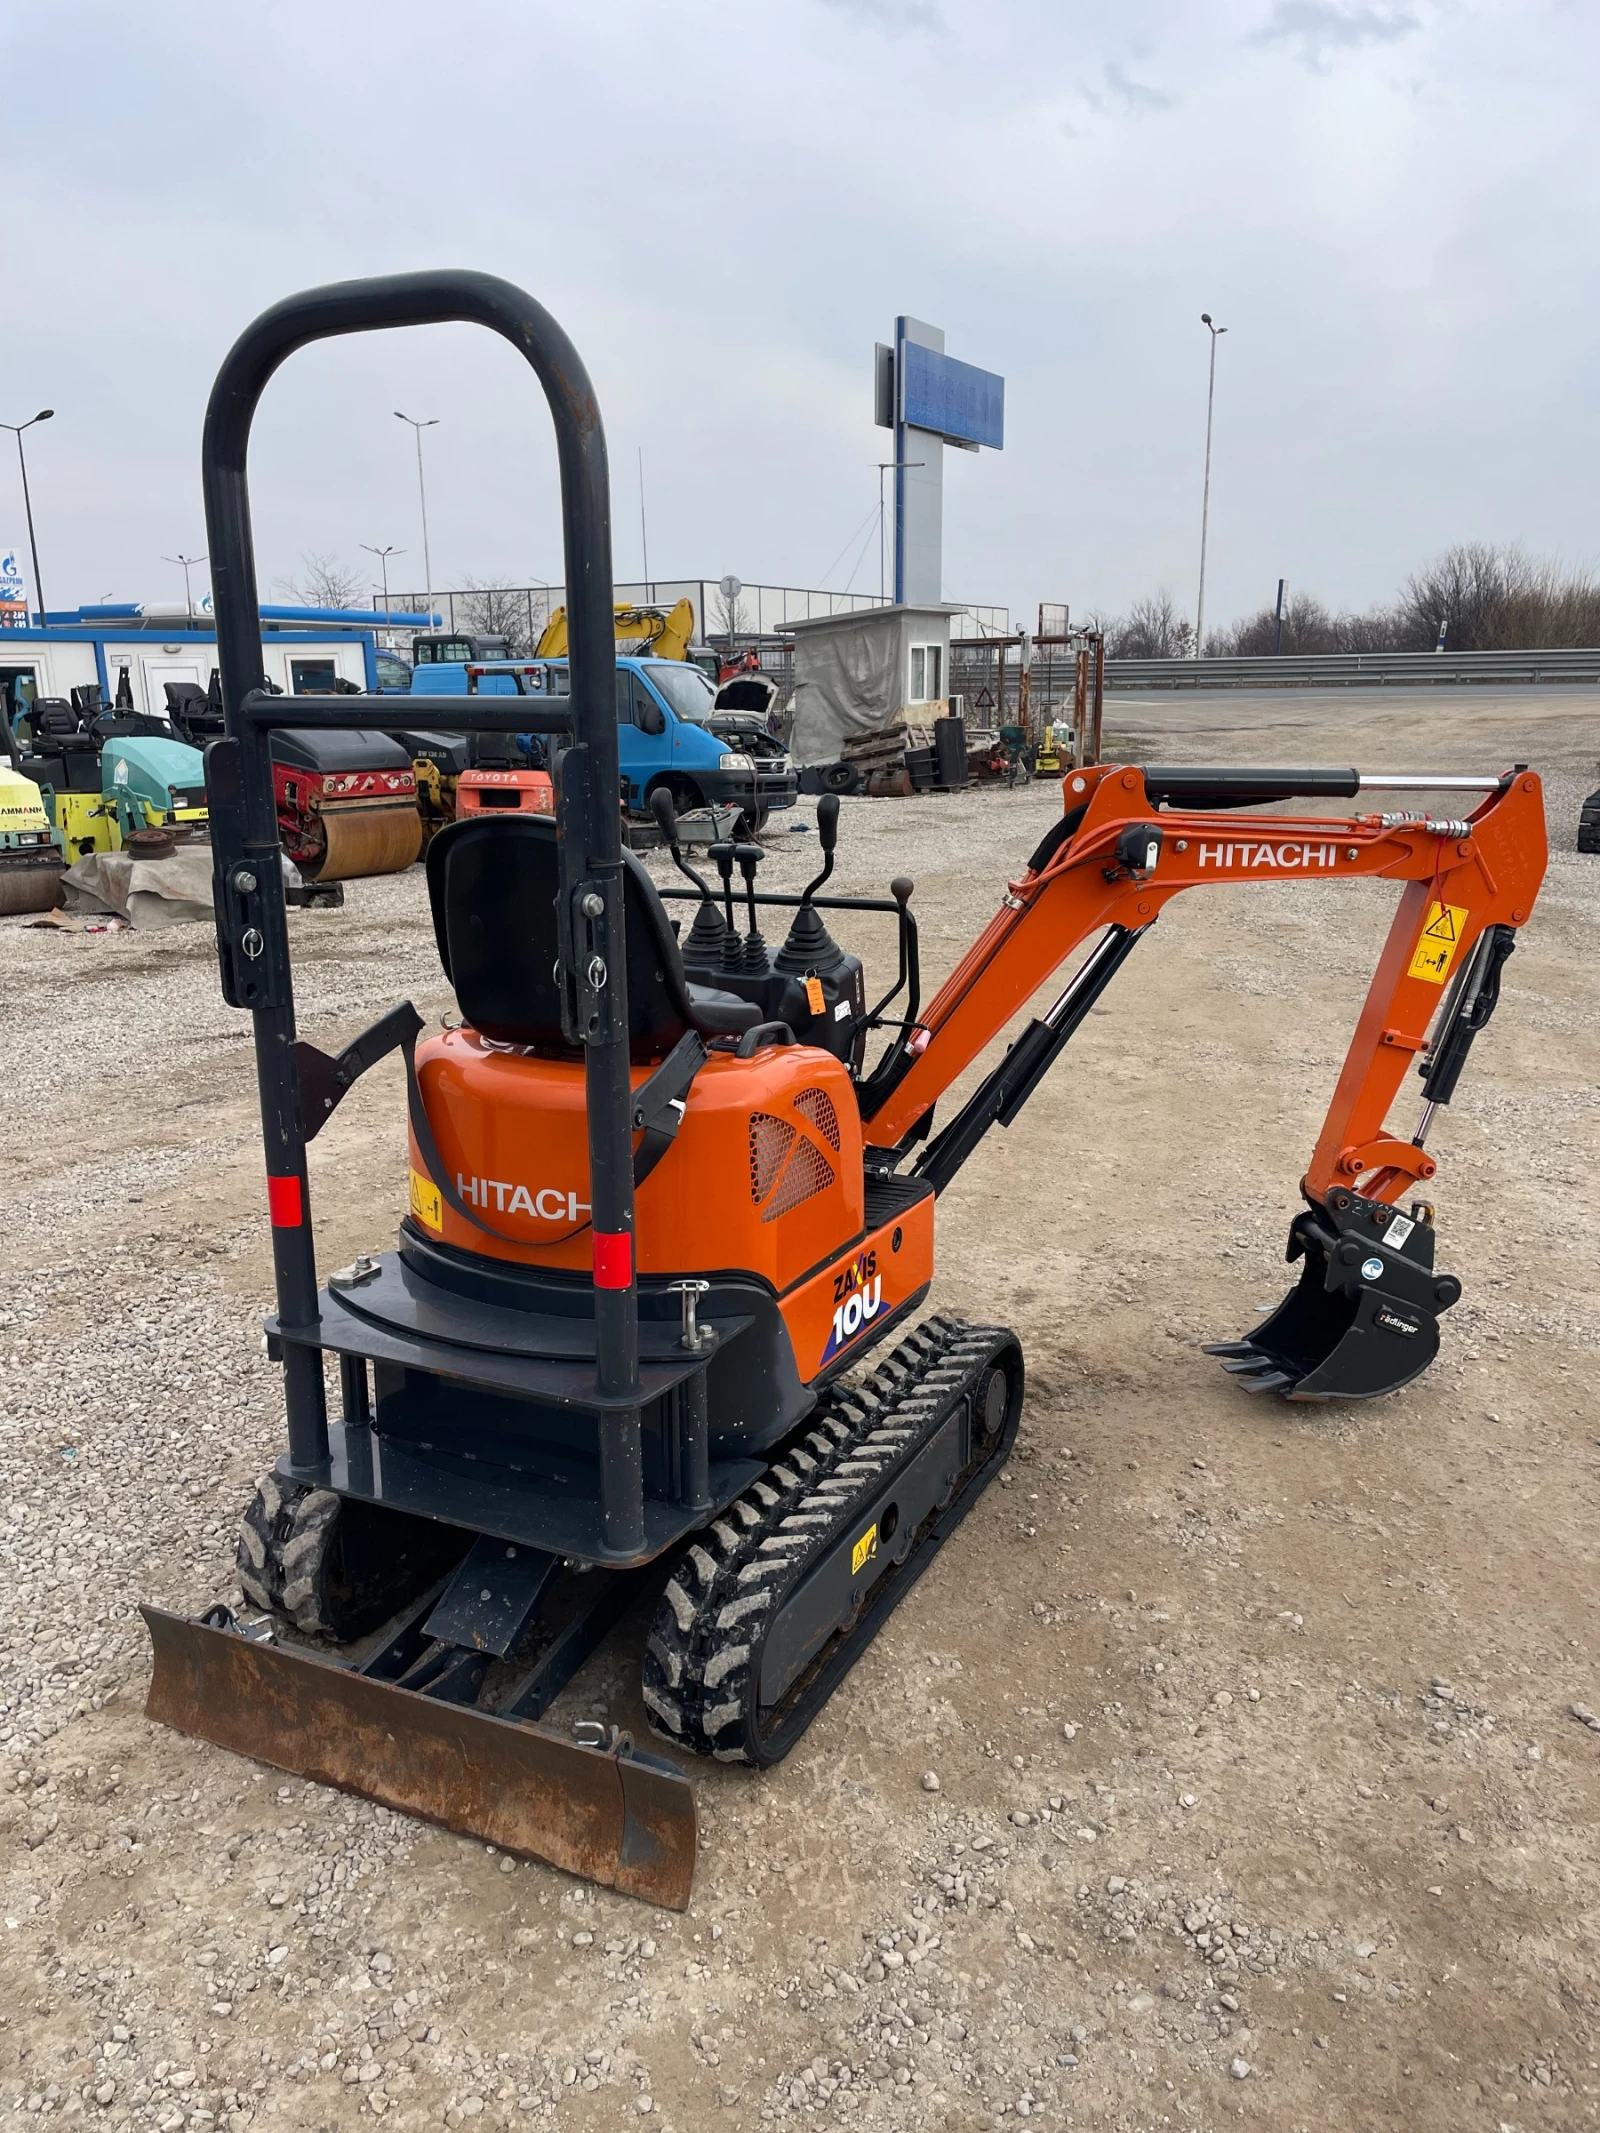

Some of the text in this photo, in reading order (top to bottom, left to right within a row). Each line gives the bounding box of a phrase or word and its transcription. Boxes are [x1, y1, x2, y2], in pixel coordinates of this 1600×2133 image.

[470, 773, 519, 783] TOYOTA
[0, 806, 42, 815] AMMANN
[1199, 843, 1337, 867] HITACHI
[456, 1172, 592, 1221] HITACH
[833, 1250, 876, 1304] ZAXIS
[833, 1273, 882, 1346] 10U
